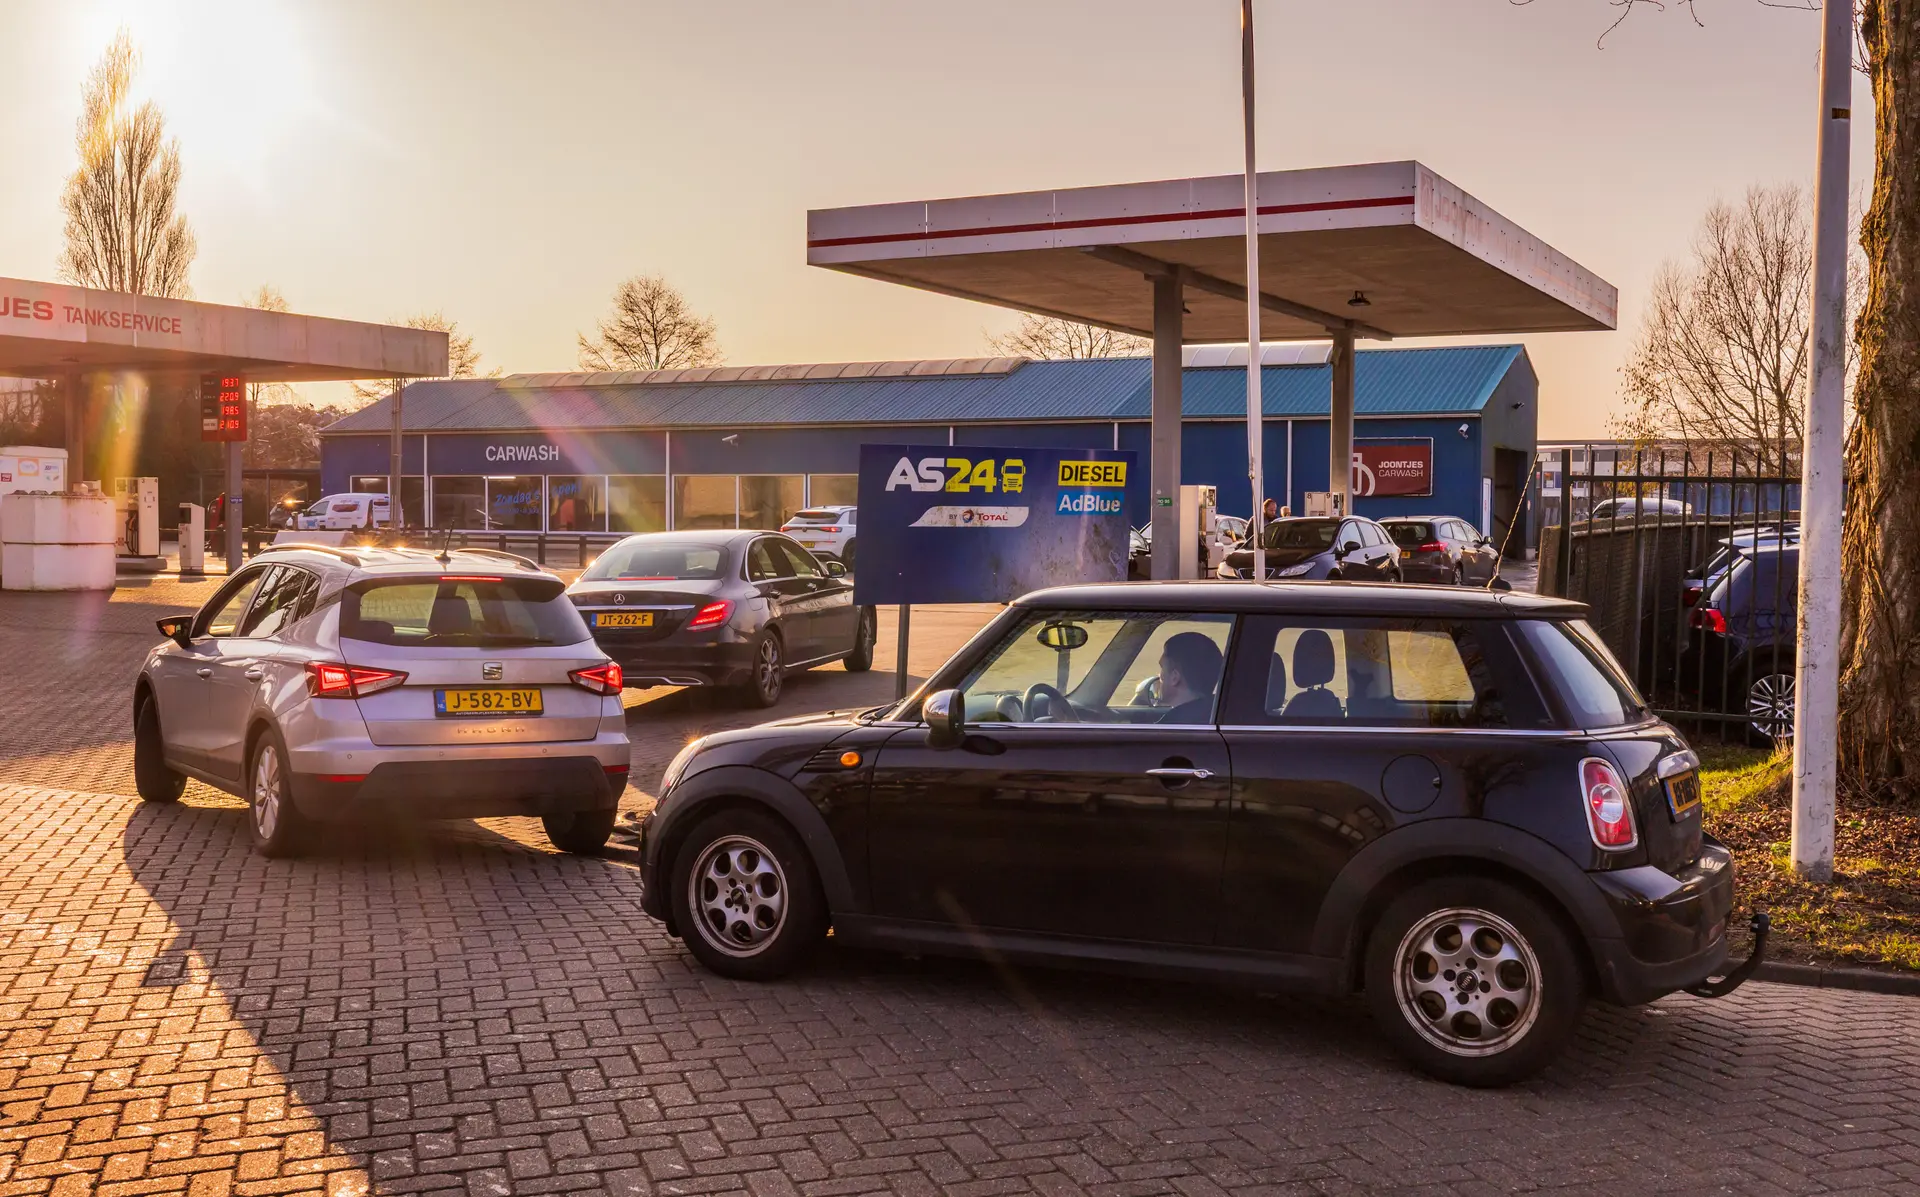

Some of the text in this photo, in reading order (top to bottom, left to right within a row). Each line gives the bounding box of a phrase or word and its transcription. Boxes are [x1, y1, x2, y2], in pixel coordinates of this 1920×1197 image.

[63, 306, 182, 334] TANKSERVICE
[221, 378, 239, 387] 1937
[219, 392, 239, 402] 2209
[485, 445, 559, 461] CARWASH
[1378, 461, 1423, 469] JOONTJES
[885, 456, 997, 493] AS24
[1061, 465, 1123, 482] DIESEL
[1058, 494, 1121, 512] AdBlue
[601, 614, 648, 625] JT-262-F
[452, 692, 533, 709] J-582-BV
